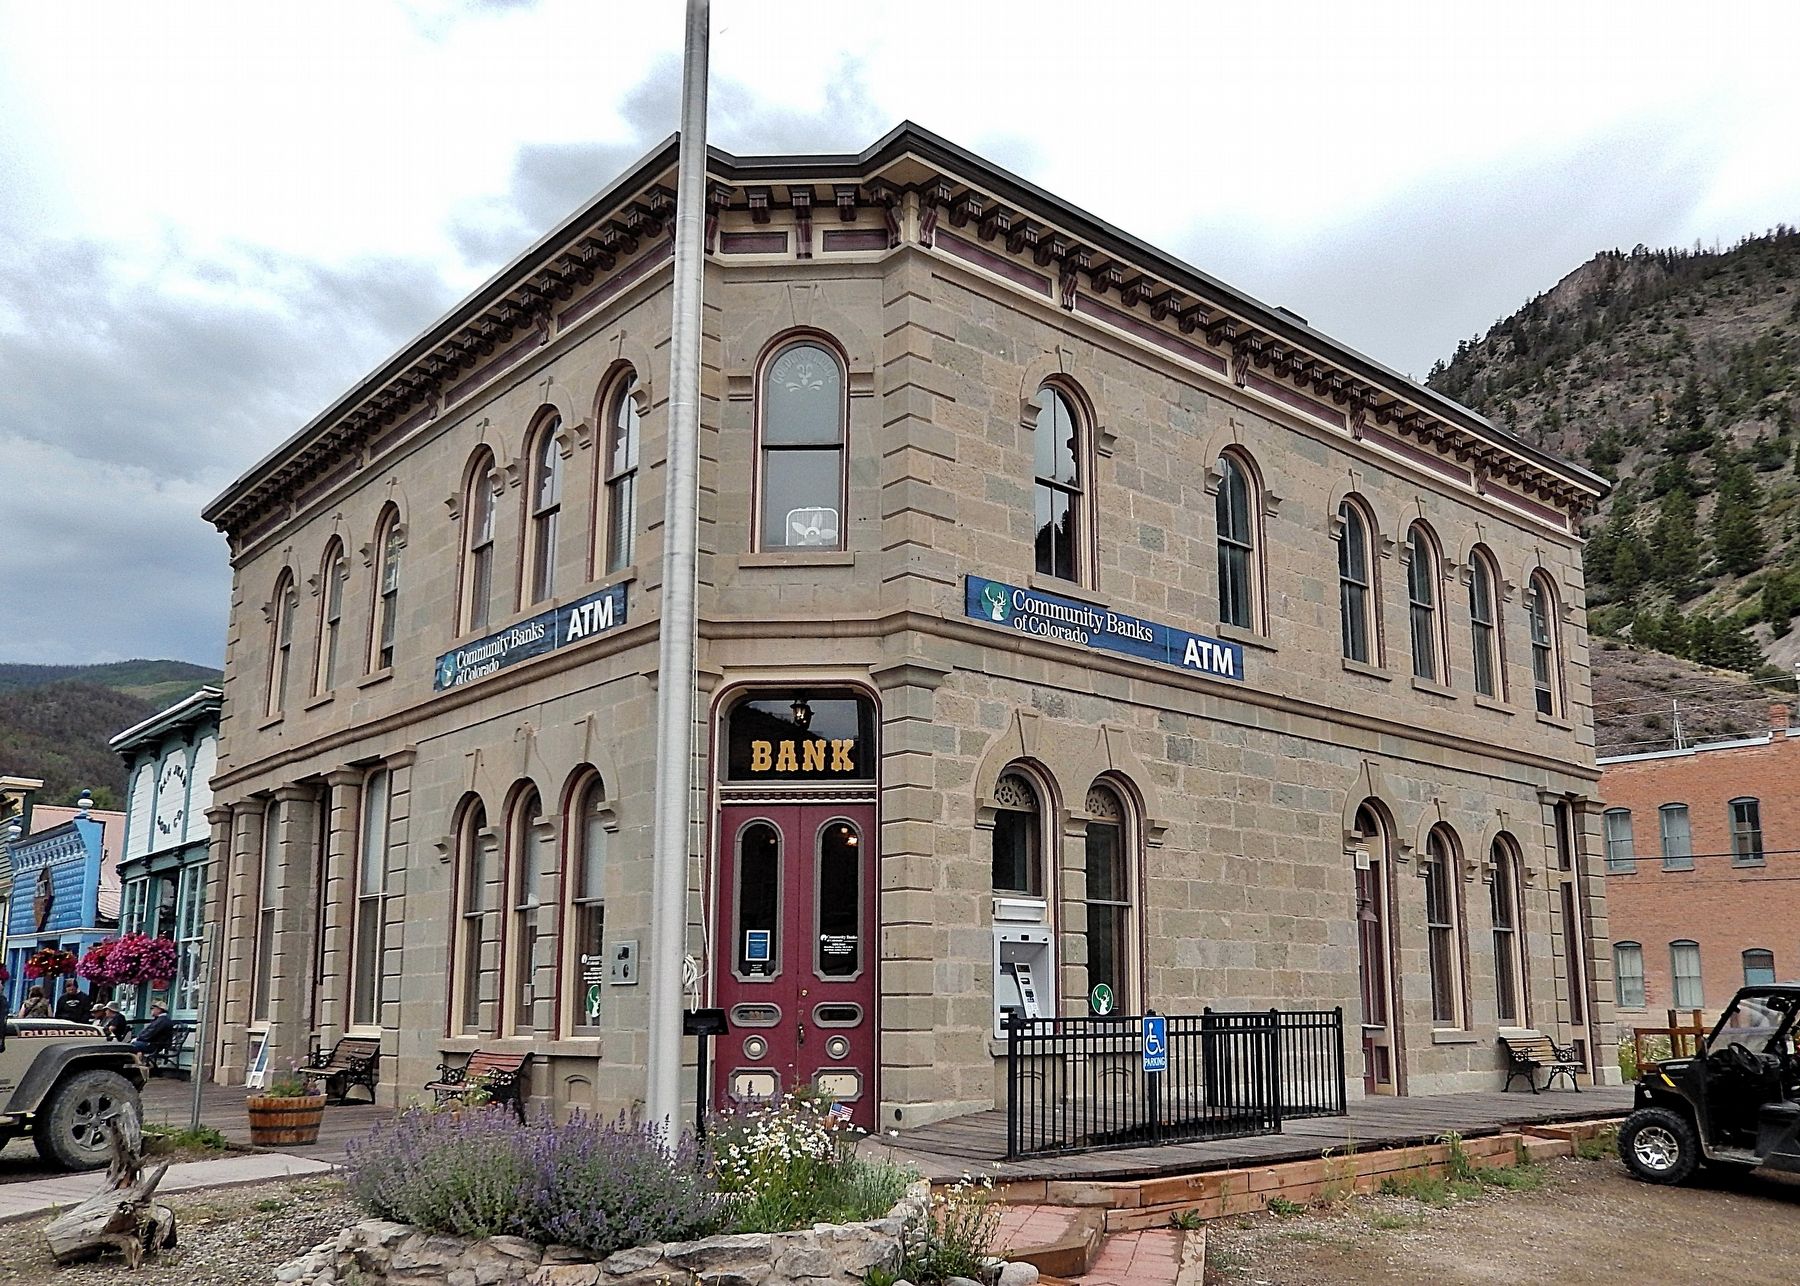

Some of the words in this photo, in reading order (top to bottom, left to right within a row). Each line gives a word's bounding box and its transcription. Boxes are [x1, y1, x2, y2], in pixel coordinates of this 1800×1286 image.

[566, 595, 614, 642] ATM
[1012, 589, 1104, 635] Community
[1106, 612, 1153, 642] Banks
[1014, 615, 1029, 630] of
[1028, 617, 1089, 645] Colorado
[456, 635, 511, 668] Community
[511, 622, 545, 648] Banks
[1183, 638, 1234, 676] ATM
[455, 668, 465, 686] of
[463, 658, 500, 684] Colorado
[750, 739, 855, 772] BANK
[20, 1029, 98, 1037] RUBICON
[1144, 1057, 1165, 1067] PARKING
